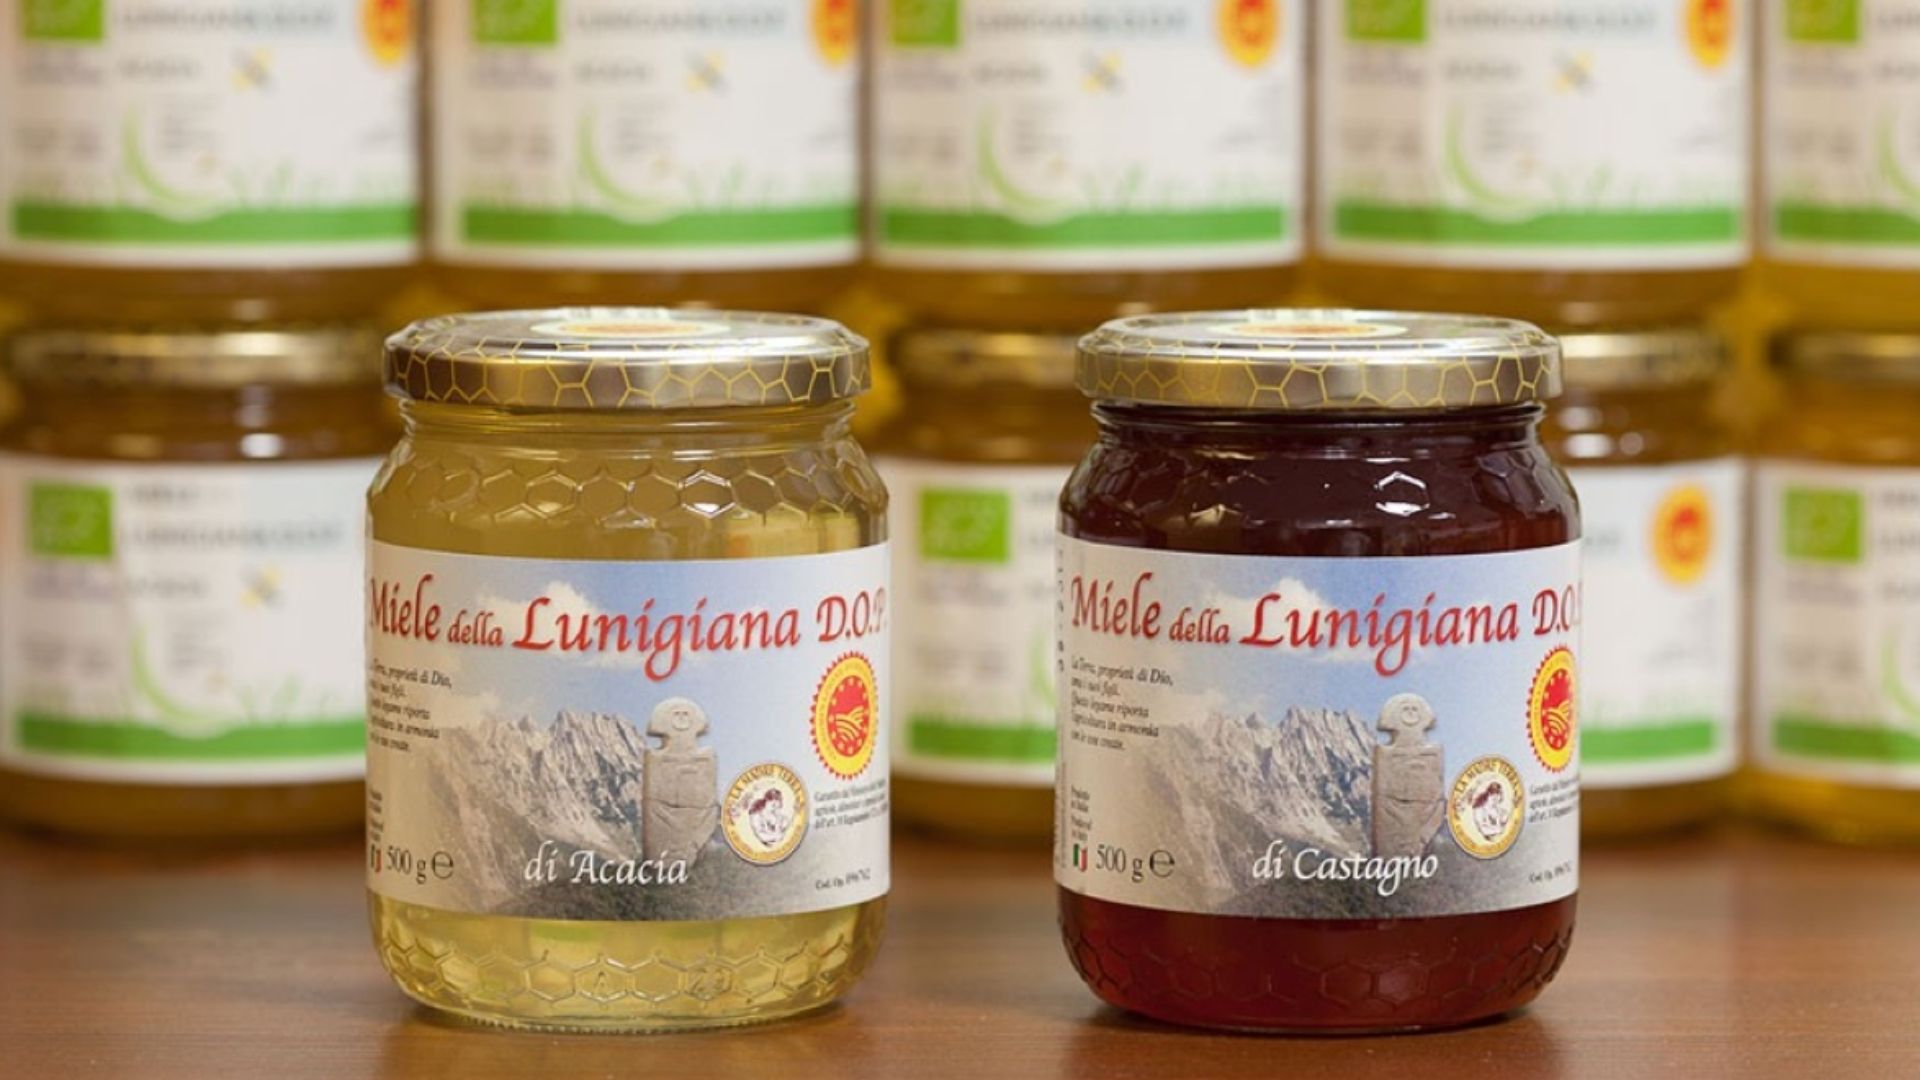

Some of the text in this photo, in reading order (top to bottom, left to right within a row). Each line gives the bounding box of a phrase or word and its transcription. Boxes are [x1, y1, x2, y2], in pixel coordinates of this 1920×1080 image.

[369, 573, 441, 640] Miele
[447, 609, 503, 646] della
[512, 597, 801, 682] Lunigiana
[1071, 571, 1161, 640] Miele
[1169, 606, 1230, 643] della
[1239, 592, 1519, 677] Lunigiana
[387, 844, 412, 875] 500
[416, 859, 428, 885] g
[524, 840, 689, 885] di Acacia
[1095, 843, 1127, 874] 500
[1131, 857, 1144, 884] g
[1252, 838, 1439, 897] di Castagno
